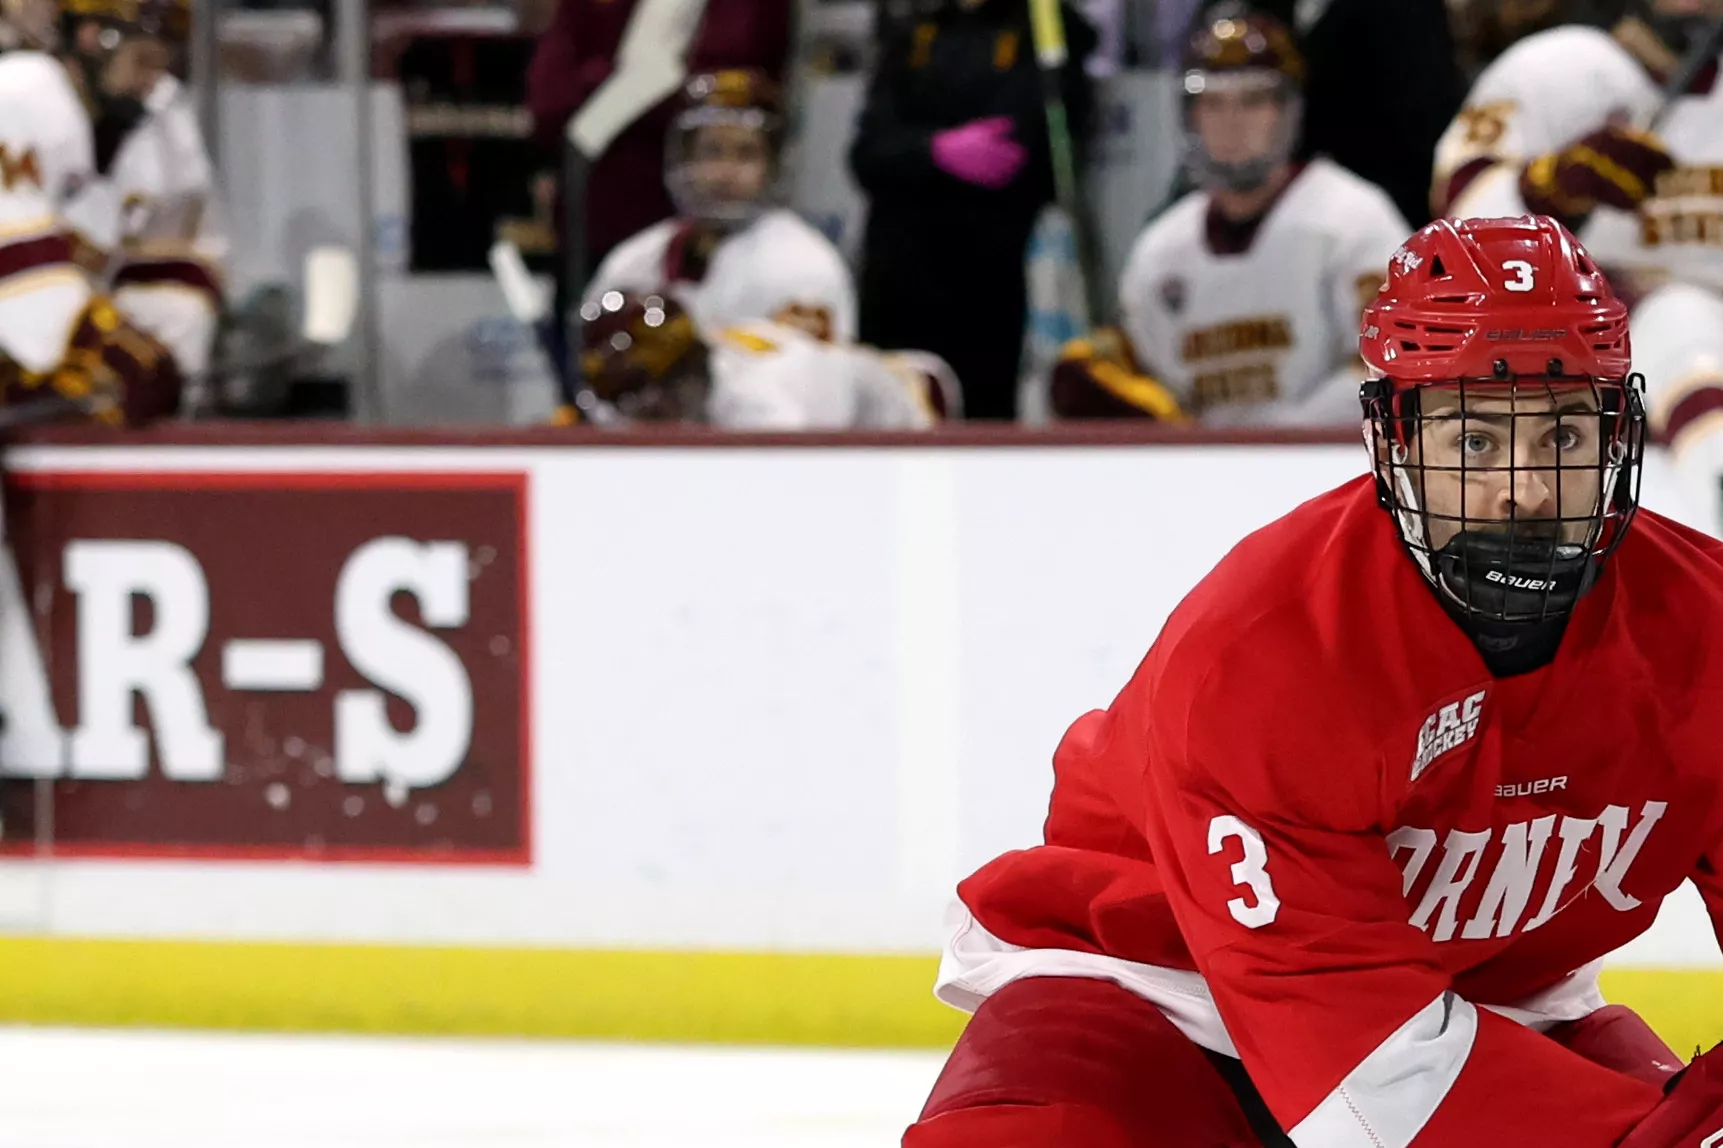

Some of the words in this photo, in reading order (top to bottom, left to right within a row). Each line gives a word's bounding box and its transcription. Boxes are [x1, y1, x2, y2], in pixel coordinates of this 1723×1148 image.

[1502, 260, 1534, 291] 3
[1485, 570, 1556, 591] BAUER
[1207, 814, 1281, 929] 3
